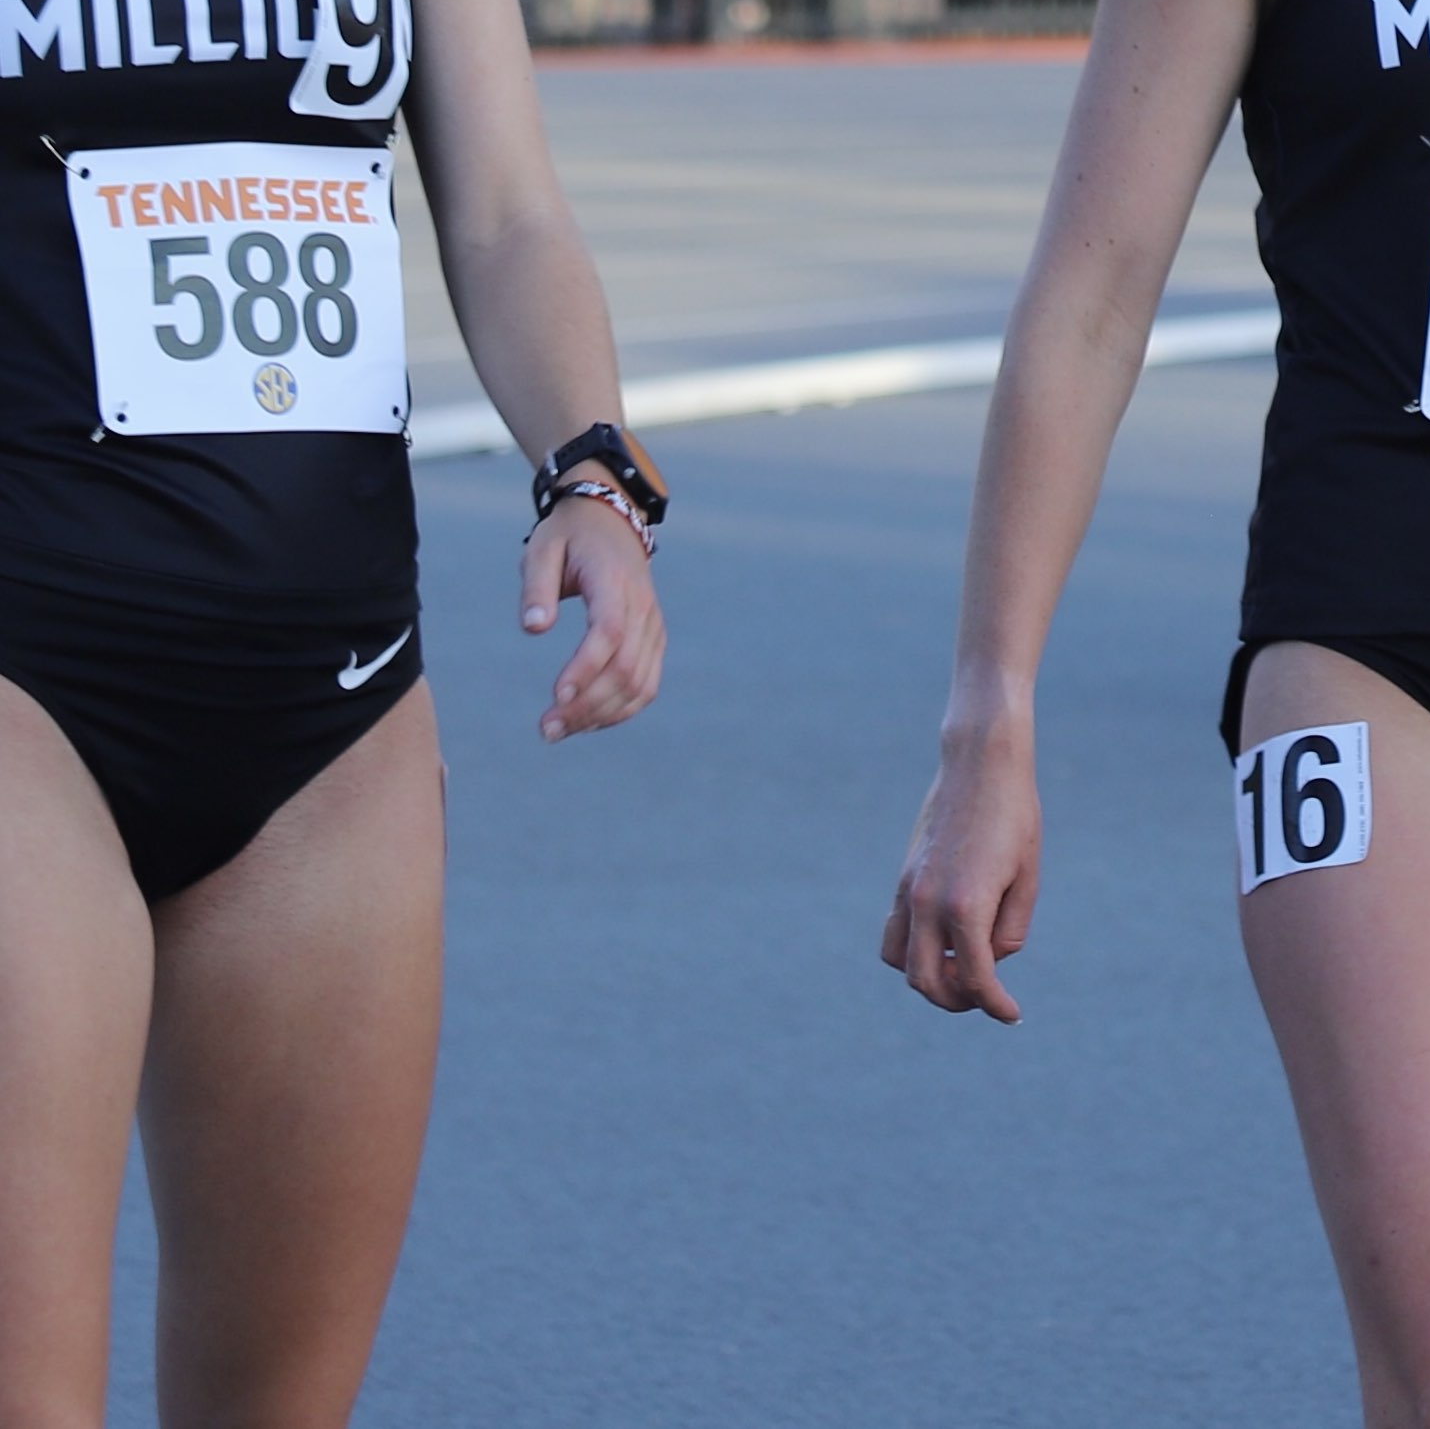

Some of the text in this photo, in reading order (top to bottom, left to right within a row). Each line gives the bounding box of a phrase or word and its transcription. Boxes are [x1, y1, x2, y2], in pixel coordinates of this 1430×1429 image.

[95, 176, 372, 228] TENNESSEE
[148, 231, 356, 360] 588
[254, 363, 297, 414] SEC
[1242, 734, 1346, 878] 16
